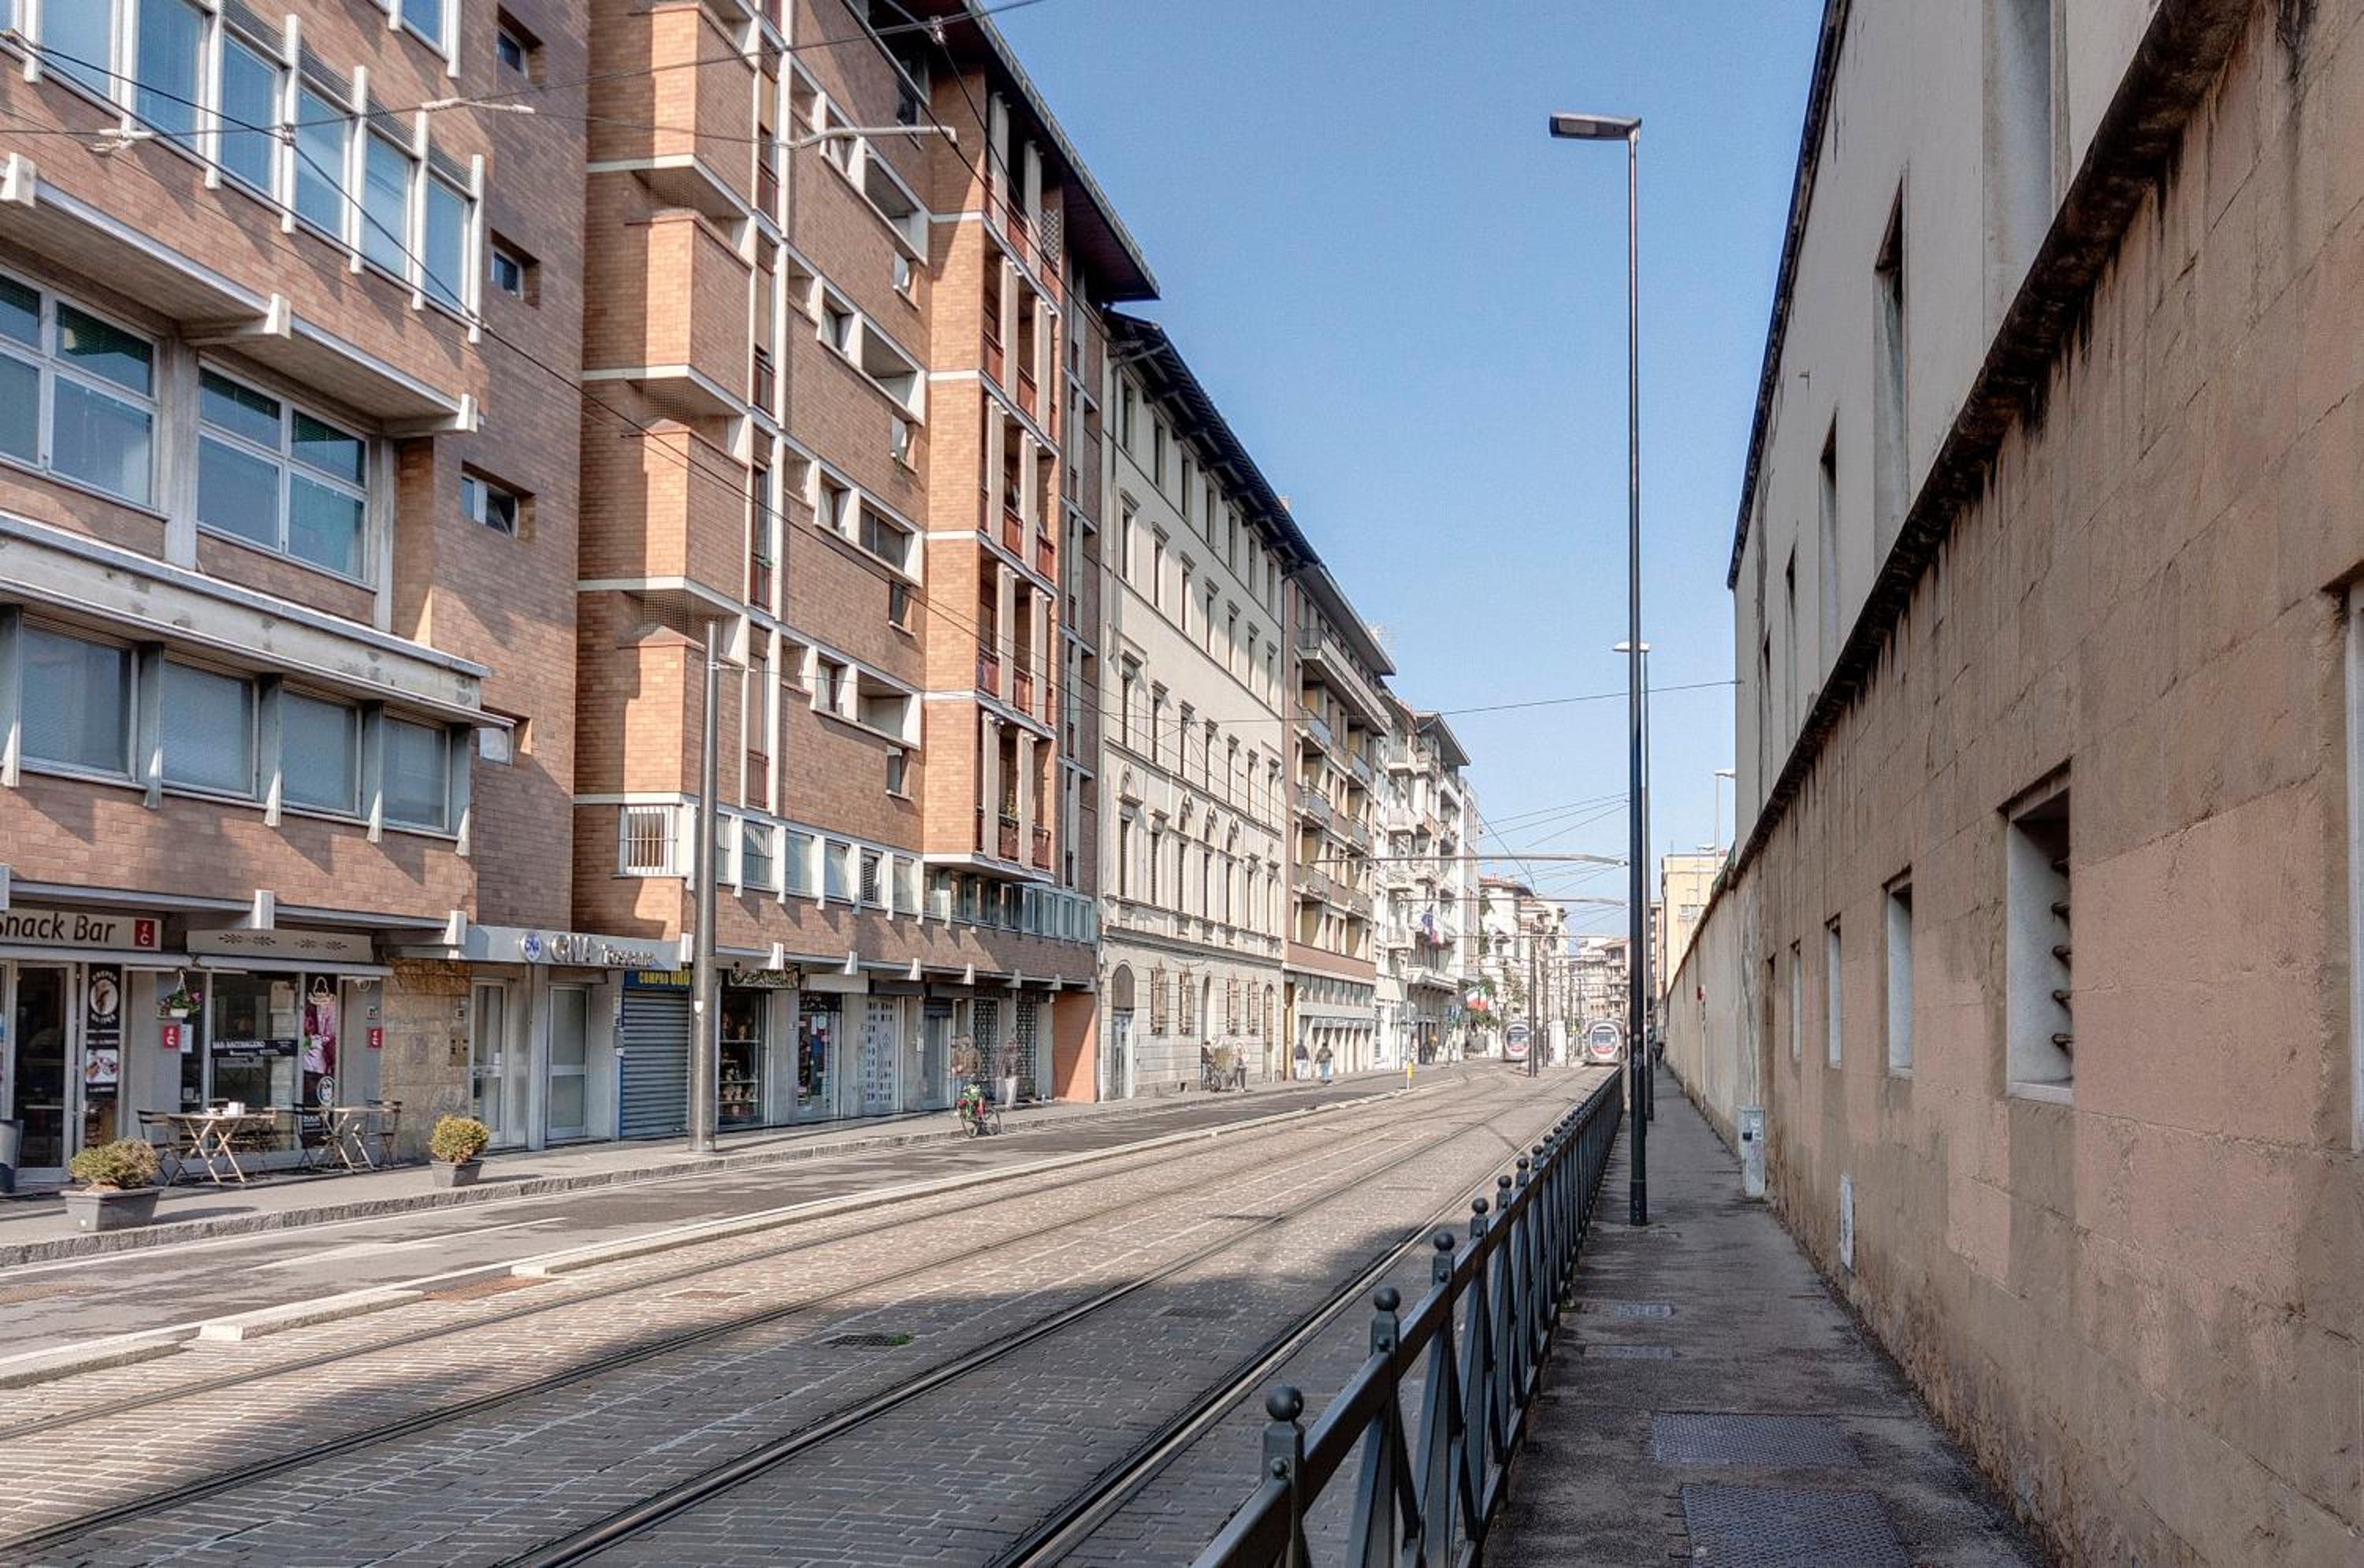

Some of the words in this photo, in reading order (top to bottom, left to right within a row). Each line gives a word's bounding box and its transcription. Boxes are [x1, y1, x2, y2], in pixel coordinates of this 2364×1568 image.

[0, 912, 65, 940] nack
[73, 915, 116, 942] Bar
[552, 934, 593, 963] CNA
